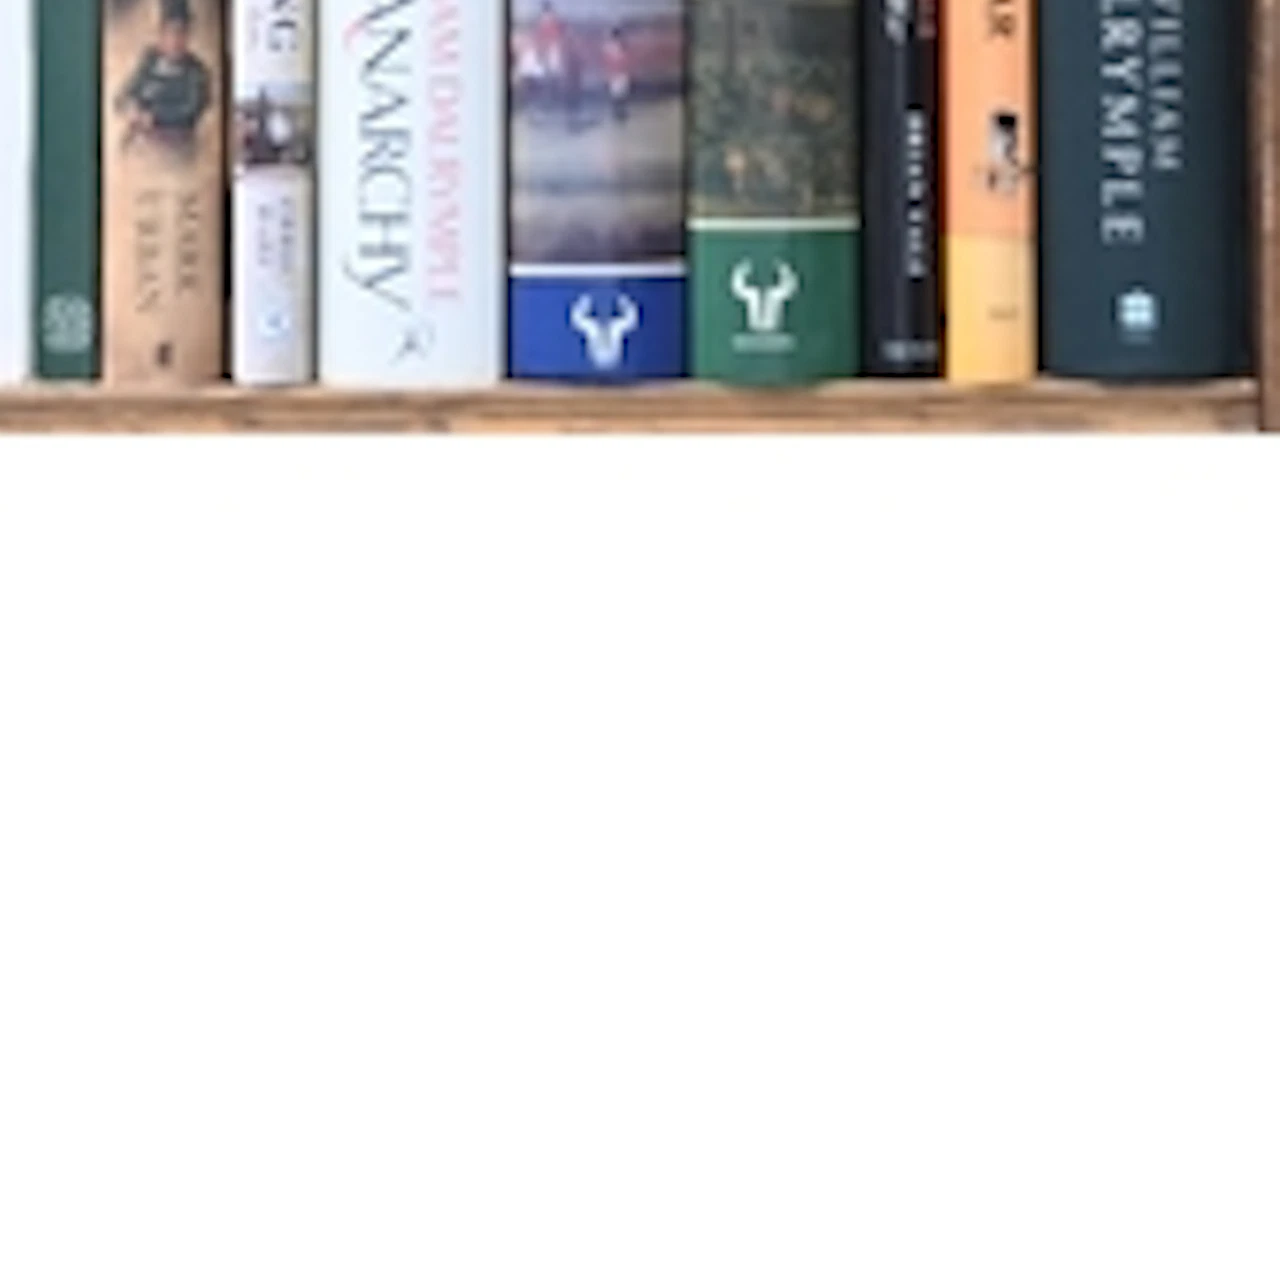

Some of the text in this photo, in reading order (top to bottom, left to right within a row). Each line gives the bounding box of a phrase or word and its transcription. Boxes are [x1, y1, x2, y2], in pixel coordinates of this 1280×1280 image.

[176, 189, 199, 293] MARK
[428, 73, 460, 302] DALRYMPLE
[134, 190, 164, 316] URBAN
